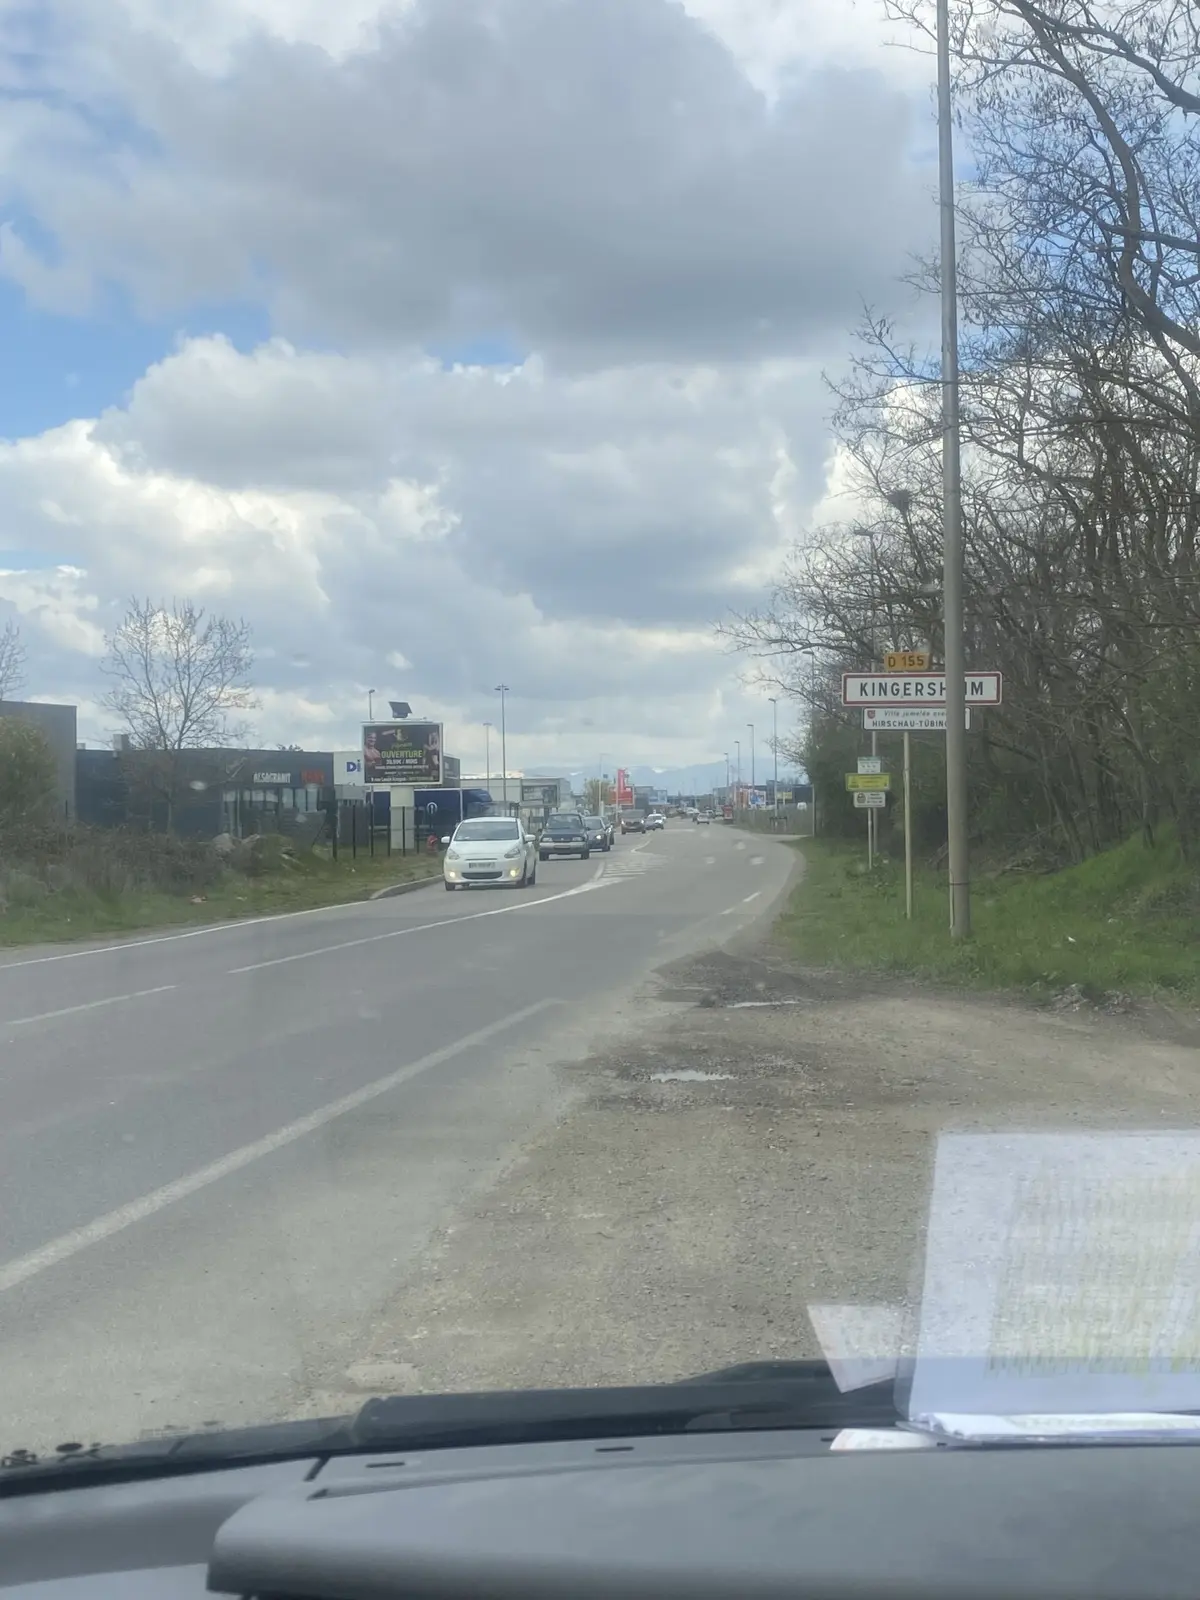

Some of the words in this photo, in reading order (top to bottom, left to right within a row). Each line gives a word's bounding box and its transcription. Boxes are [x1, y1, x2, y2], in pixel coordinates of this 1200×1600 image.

[887, 656, 896, 668] D
[901, 655, 925, 667] 155
[860, 681, 984, 697] KINGERSHIM
[381, 749, 423, 759] OUVERTURE
